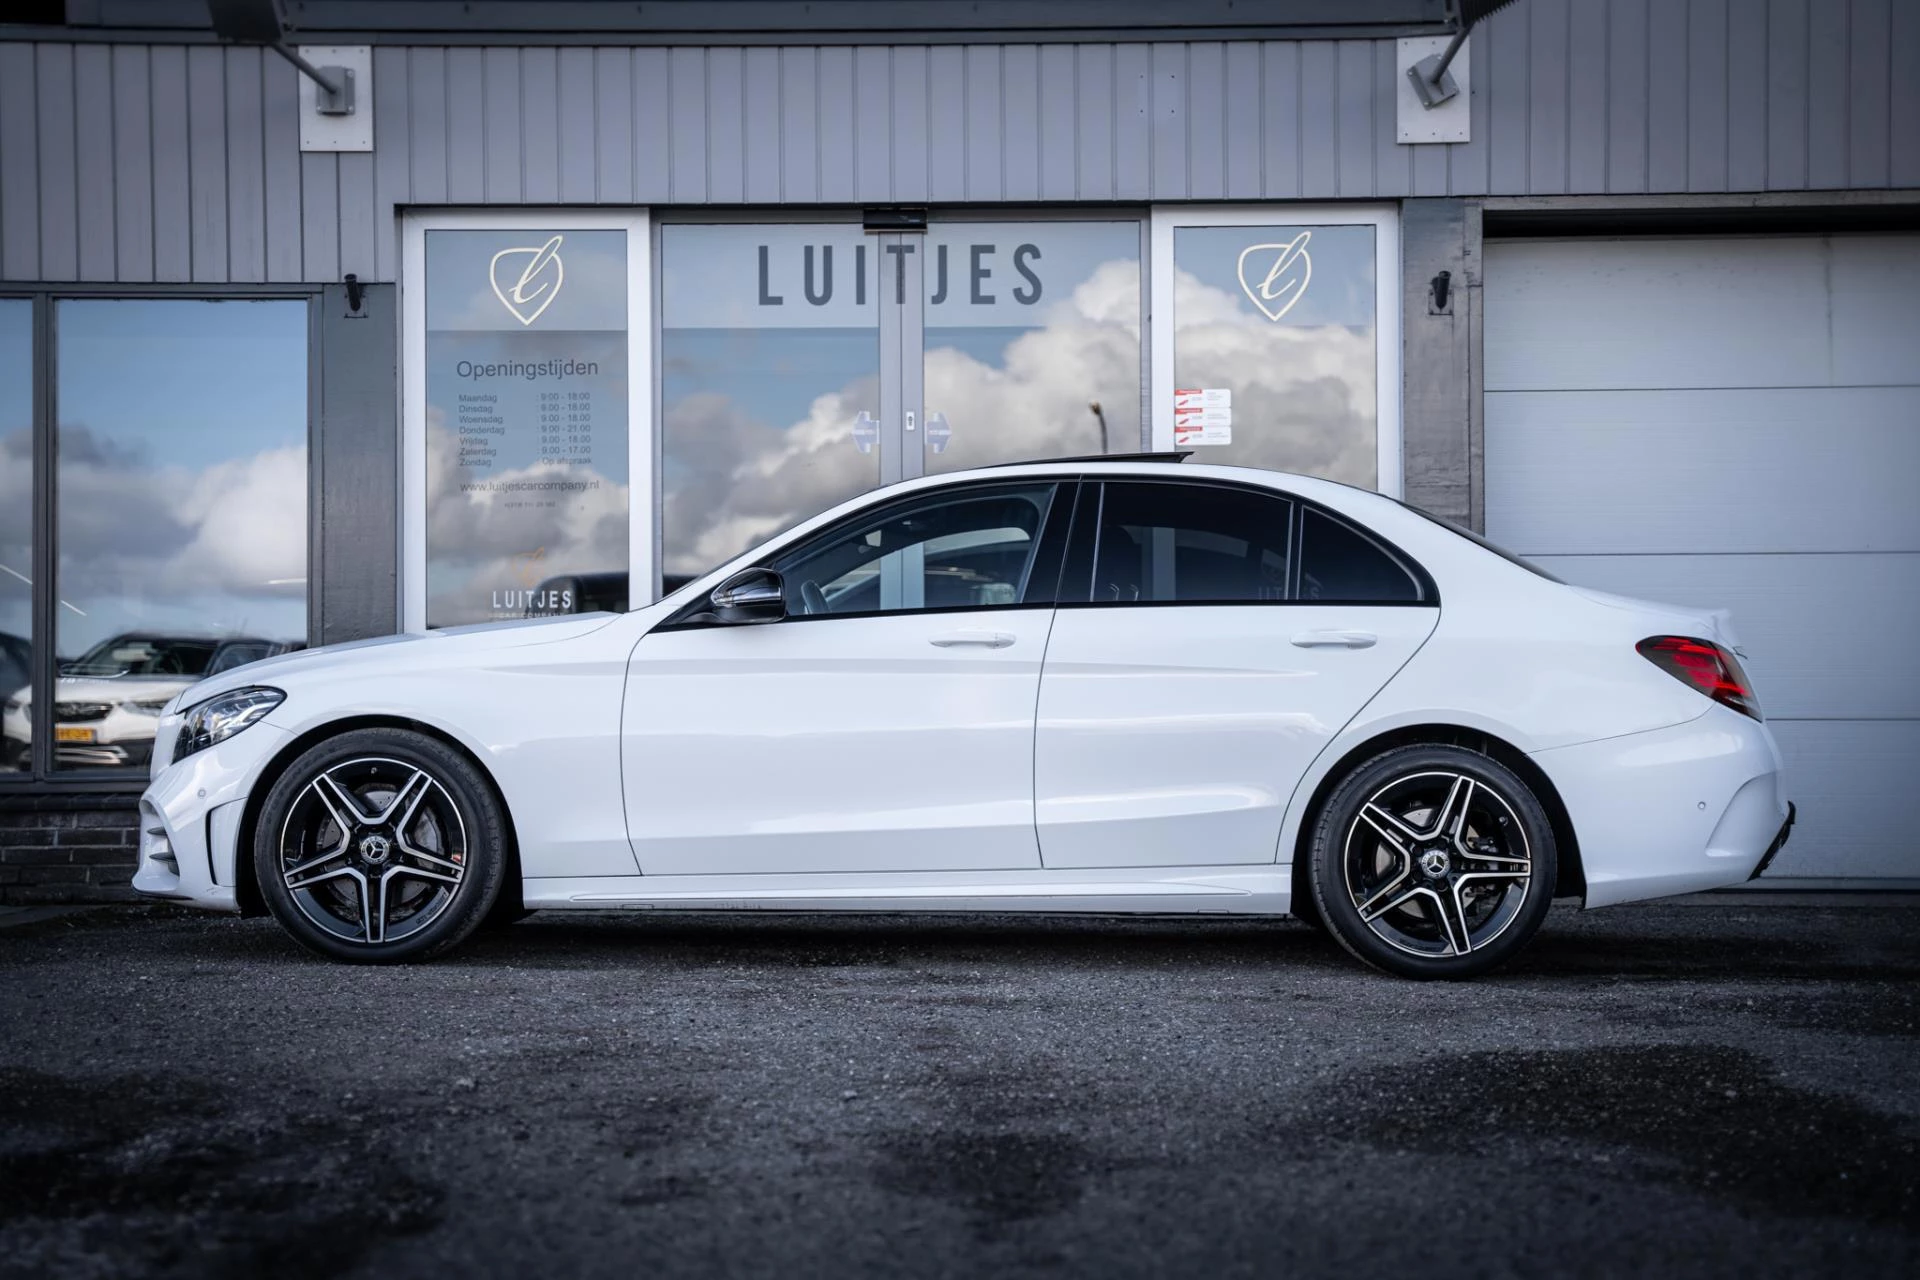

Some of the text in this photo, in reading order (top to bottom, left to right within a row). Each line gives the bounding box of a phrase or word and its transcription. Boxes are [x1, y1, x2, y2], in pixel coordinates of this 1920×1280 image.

[758, 243, 1043, 306] LUITJES
[456, 359, 598, 381] Openingstijden
[459, 394, 497, 404] Maandag
[459, 405, 493, 414] Dinsdag
[459, 415, 504, 424] Woensdag
[459, 426, 505, 436] Donderdag
[459, 437, 488, 446] Vrijdag
[459, 447, 497, 457] Zaterdag
[459, 458, 492, 467] Zondag
[459, 480, 600, 493] www.luitjescarcompany.nl
[493, 590, 571, 609] LUITJES
